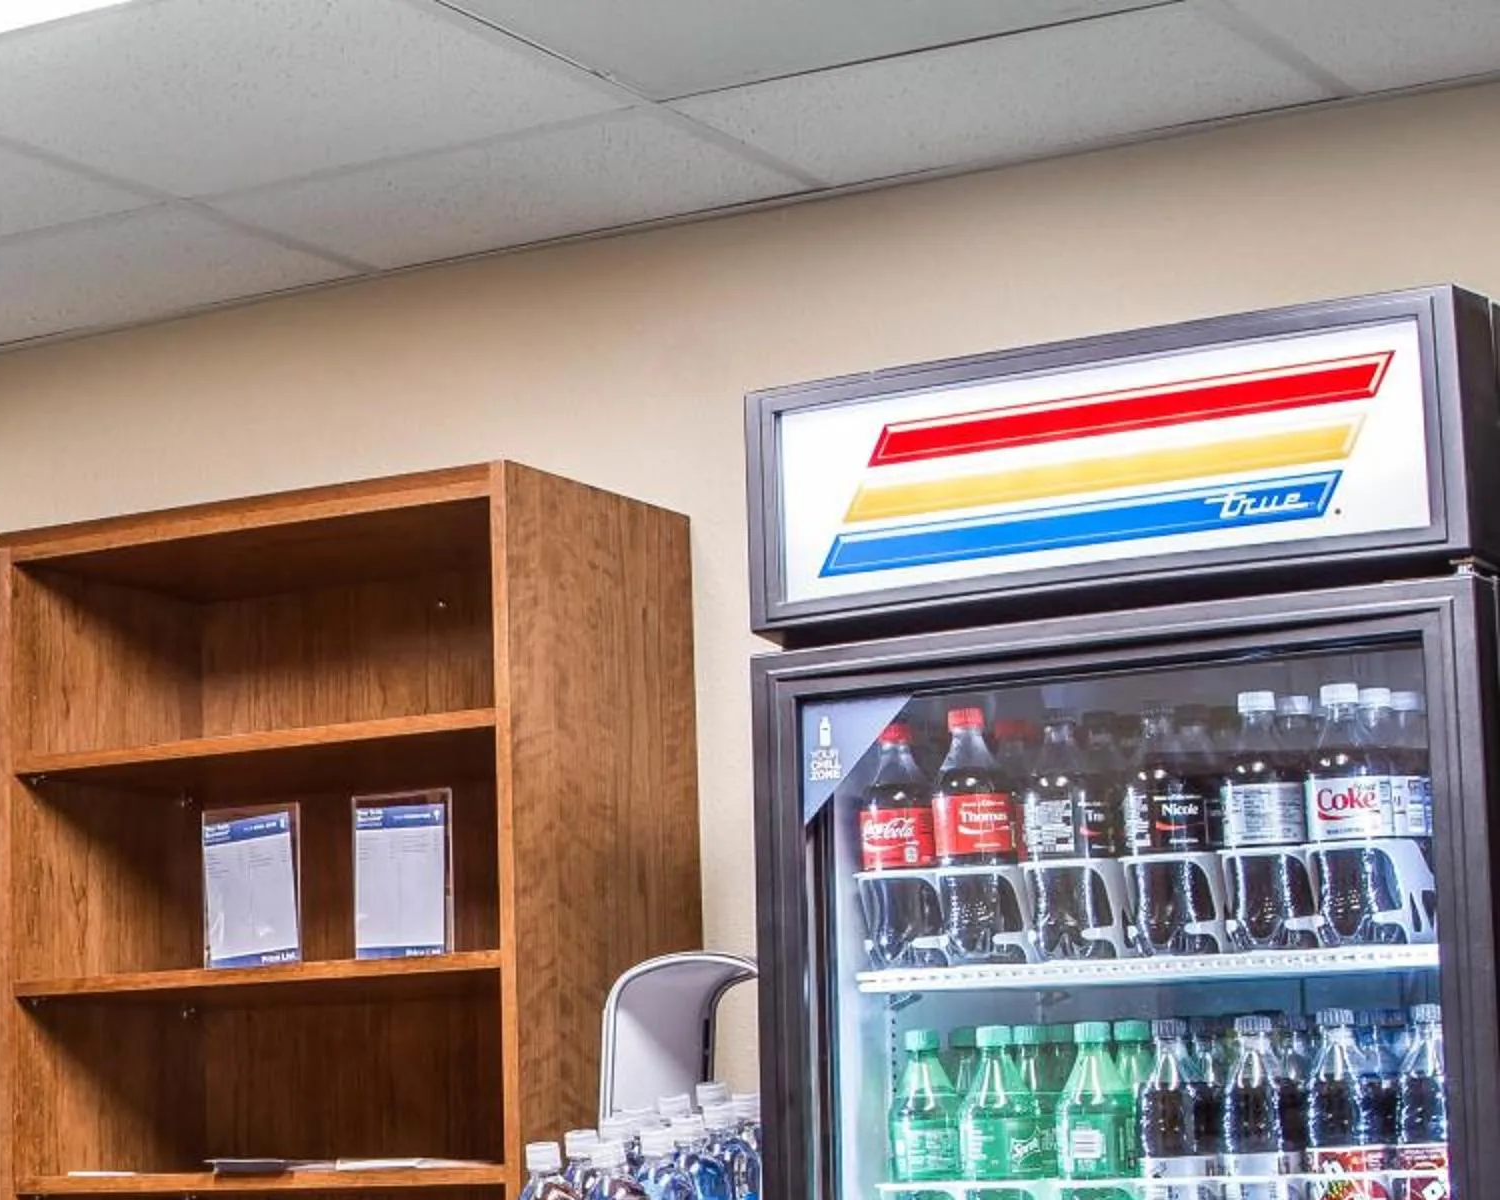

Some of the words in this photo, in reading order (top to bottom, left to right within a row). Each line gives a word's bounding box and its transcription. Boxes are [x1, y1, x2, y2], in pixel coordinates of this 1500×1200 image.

[1204, 490, 1308, 520] true
[1161, 803, 1200, 816] Nicole
[1317, 787, 1376, 811] Coke
